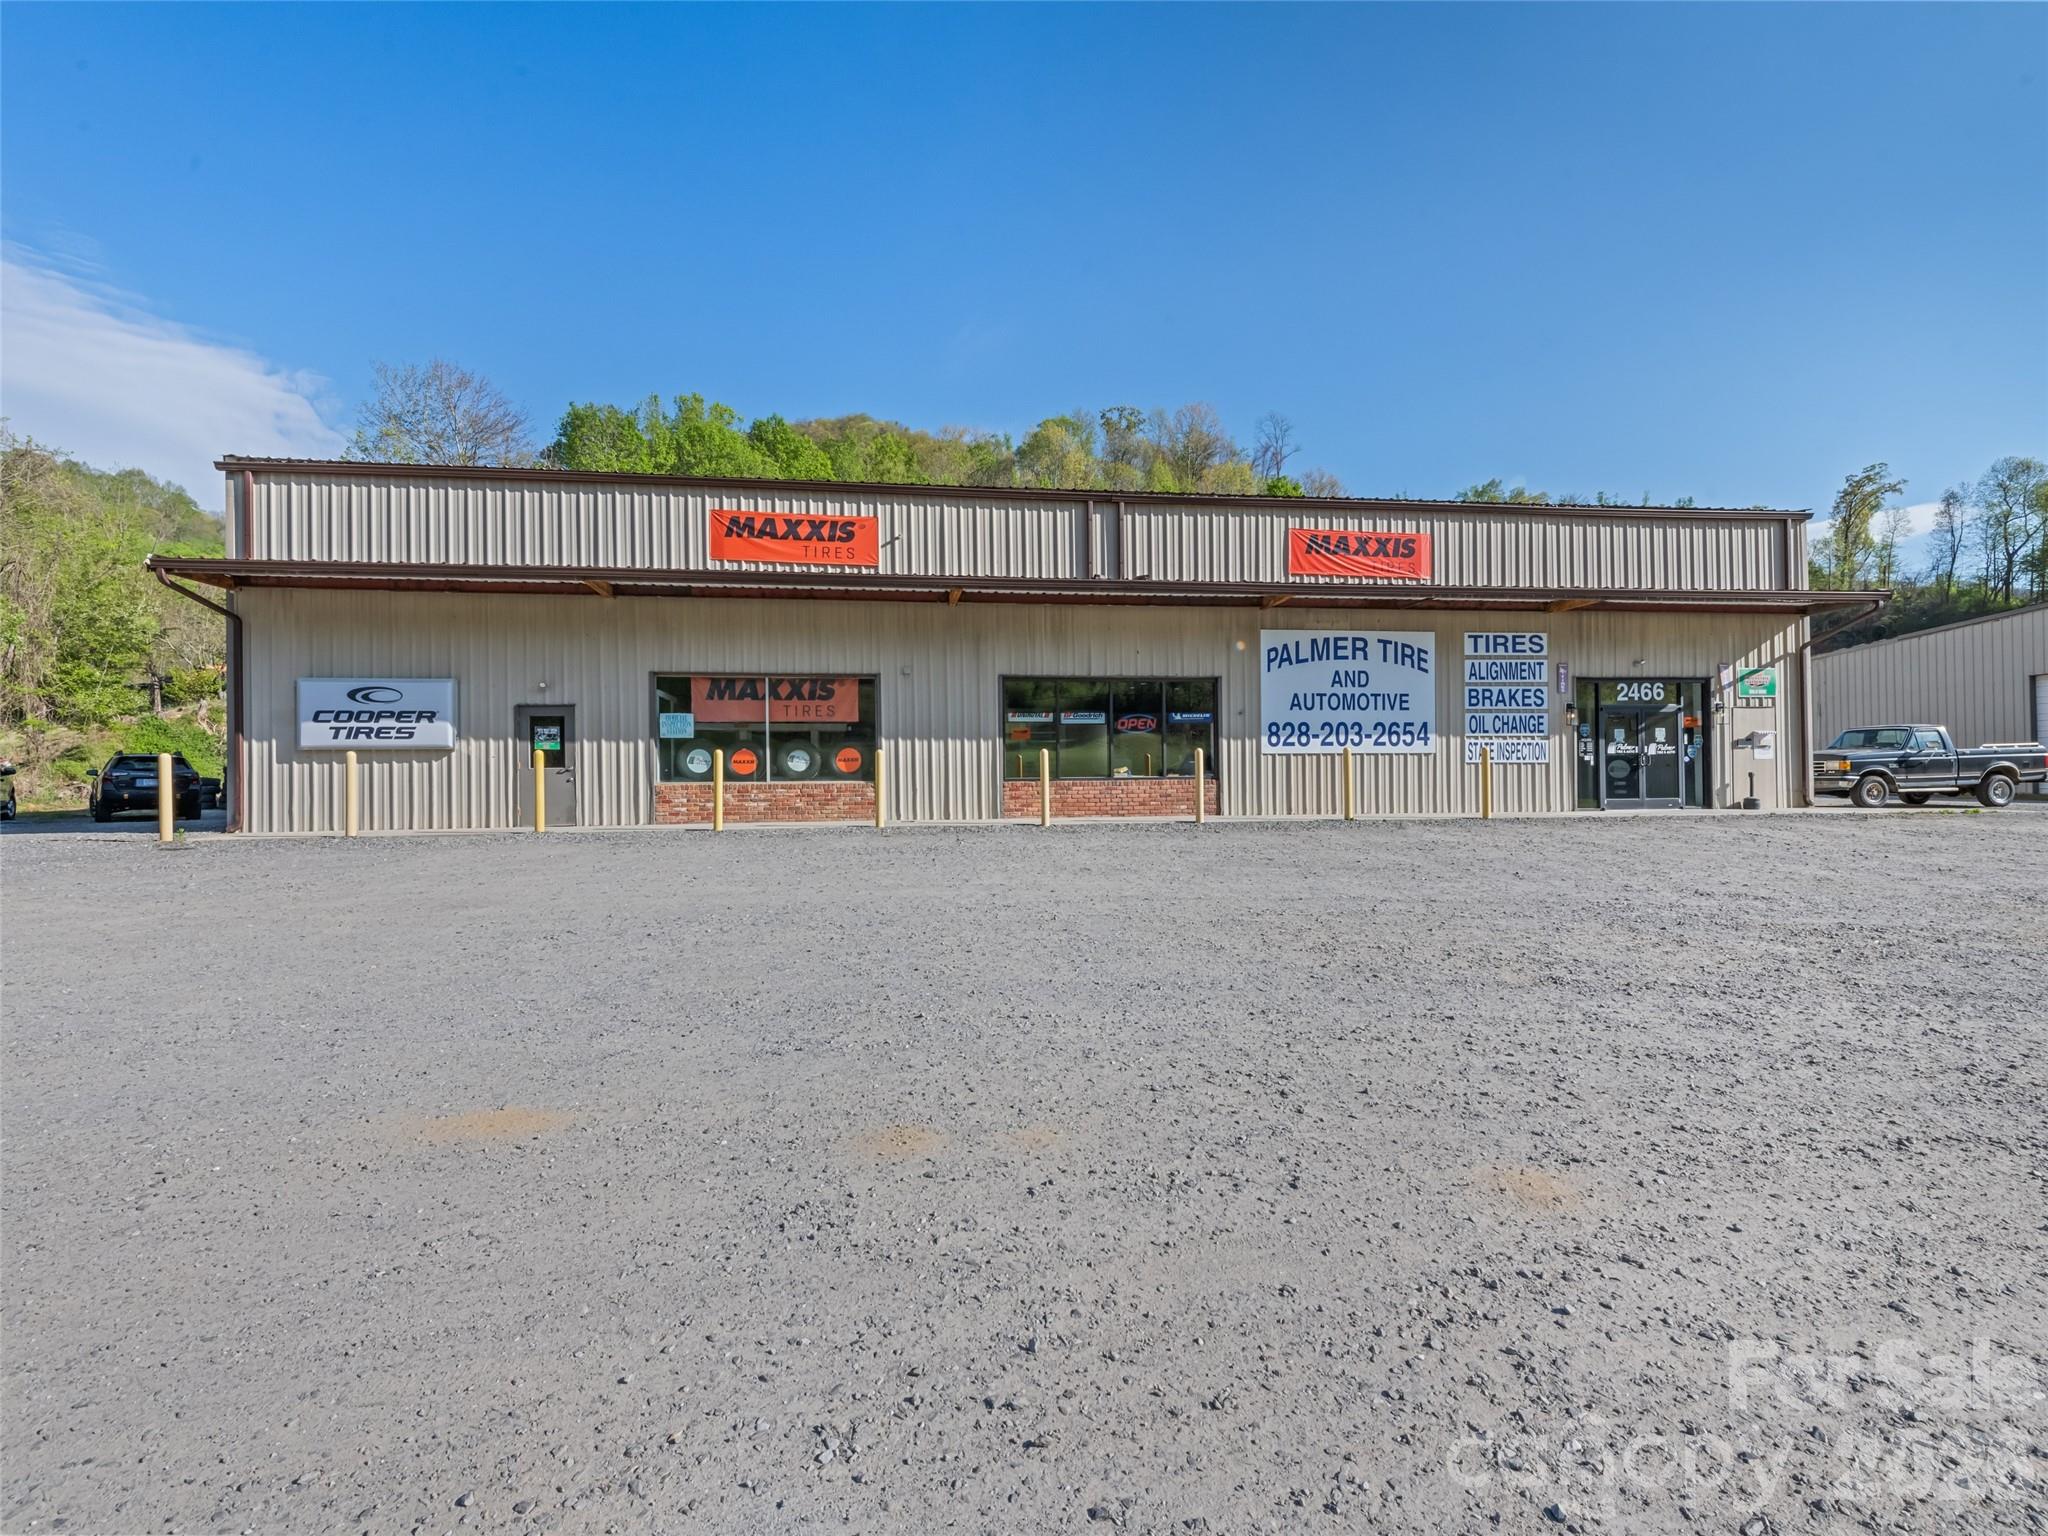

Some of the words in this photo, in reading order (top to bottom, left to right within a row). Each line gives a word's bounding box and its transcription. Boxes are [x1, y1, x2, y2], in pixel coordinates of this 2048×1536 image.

[725, 516, 857, 543] MAXXIS
[803, 545, 856, 560] TIRES
[1305, 534, 1417, 559] MAXXIS
[1468, 634, 1545, 654] TIRES
[1266, 636, 1369, 672] PALMER
[1377, 638, 1429, 674] TIRE
[1331, 670, 1370, 688] AND
[1468, 662, 1545, 681] ALIGNMENT
[705, 678, 836, 701] MAXXIS
[1468, 688, 1545, 707] BRAKES
[1616, 682, 1665, 702] 2466
[784, 704, 836, 718] TIRES
[1289, 692, 1410, 711] AUTOMOTIVE
[312, 710, 437, 724] COOPER
[1117, 718, 1157, 730] OPEN
[1469, 714, 1490, 733] OIL
[1492, 714, 1545, 734] CHANGE
[329, 726, 417, 740] TIRES
[1267, 721, 1430, 747] 828-203-2654
[1467, 742, 1495, 760] STAE
[1496, 742, 1547, 760] INSPECTION
